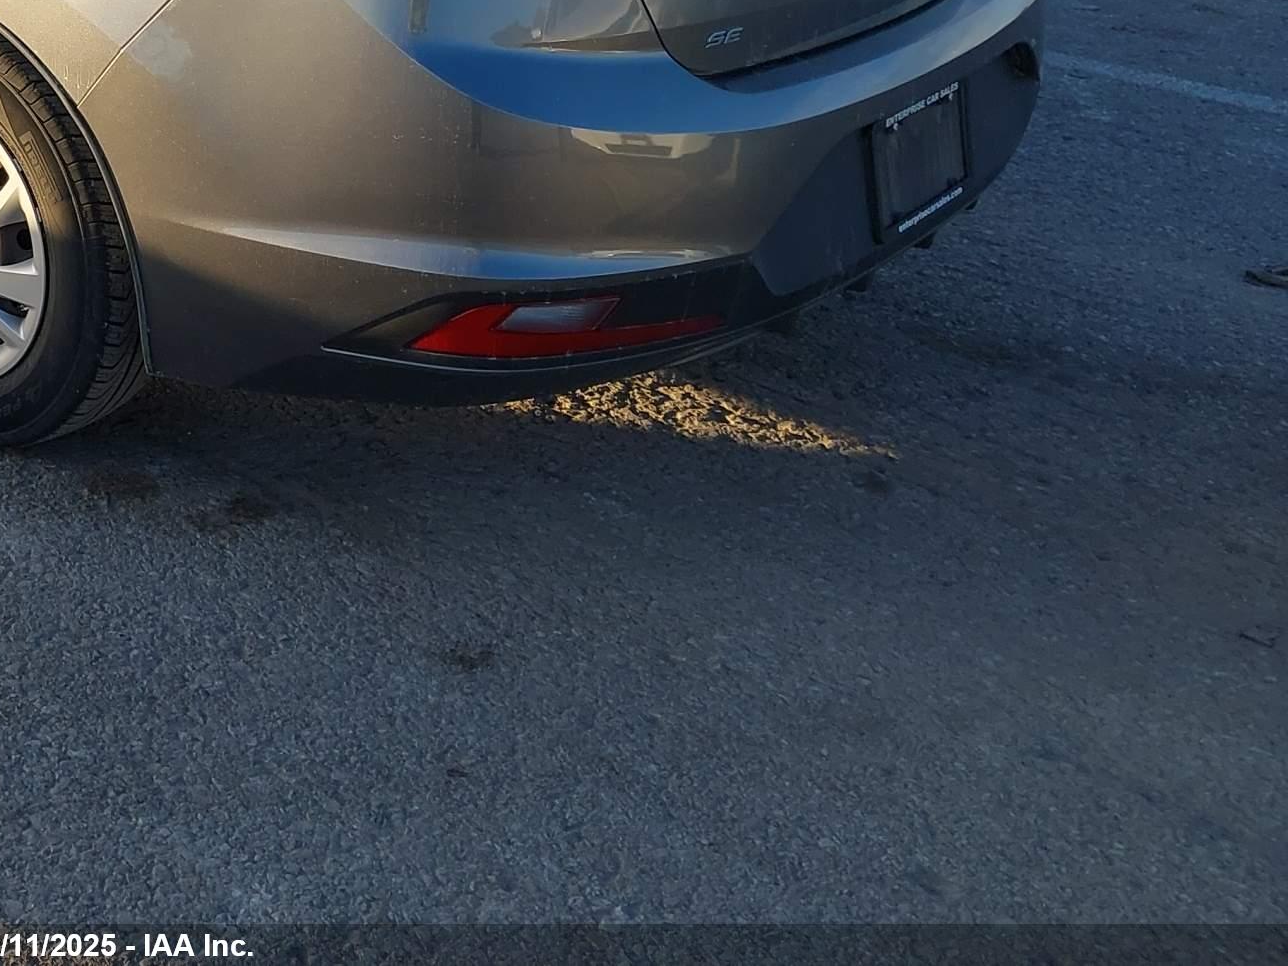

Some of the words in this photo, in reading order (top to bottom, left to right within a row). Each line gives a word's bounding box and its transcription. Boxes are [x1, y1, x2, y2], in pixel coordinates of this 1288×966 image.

[705, 27, 743, 49] SE
[886, 99, 927, 128] ENTERPRISE
[926, 91, 940, 106] CAR
[940, 81, 959, 100] SALES
